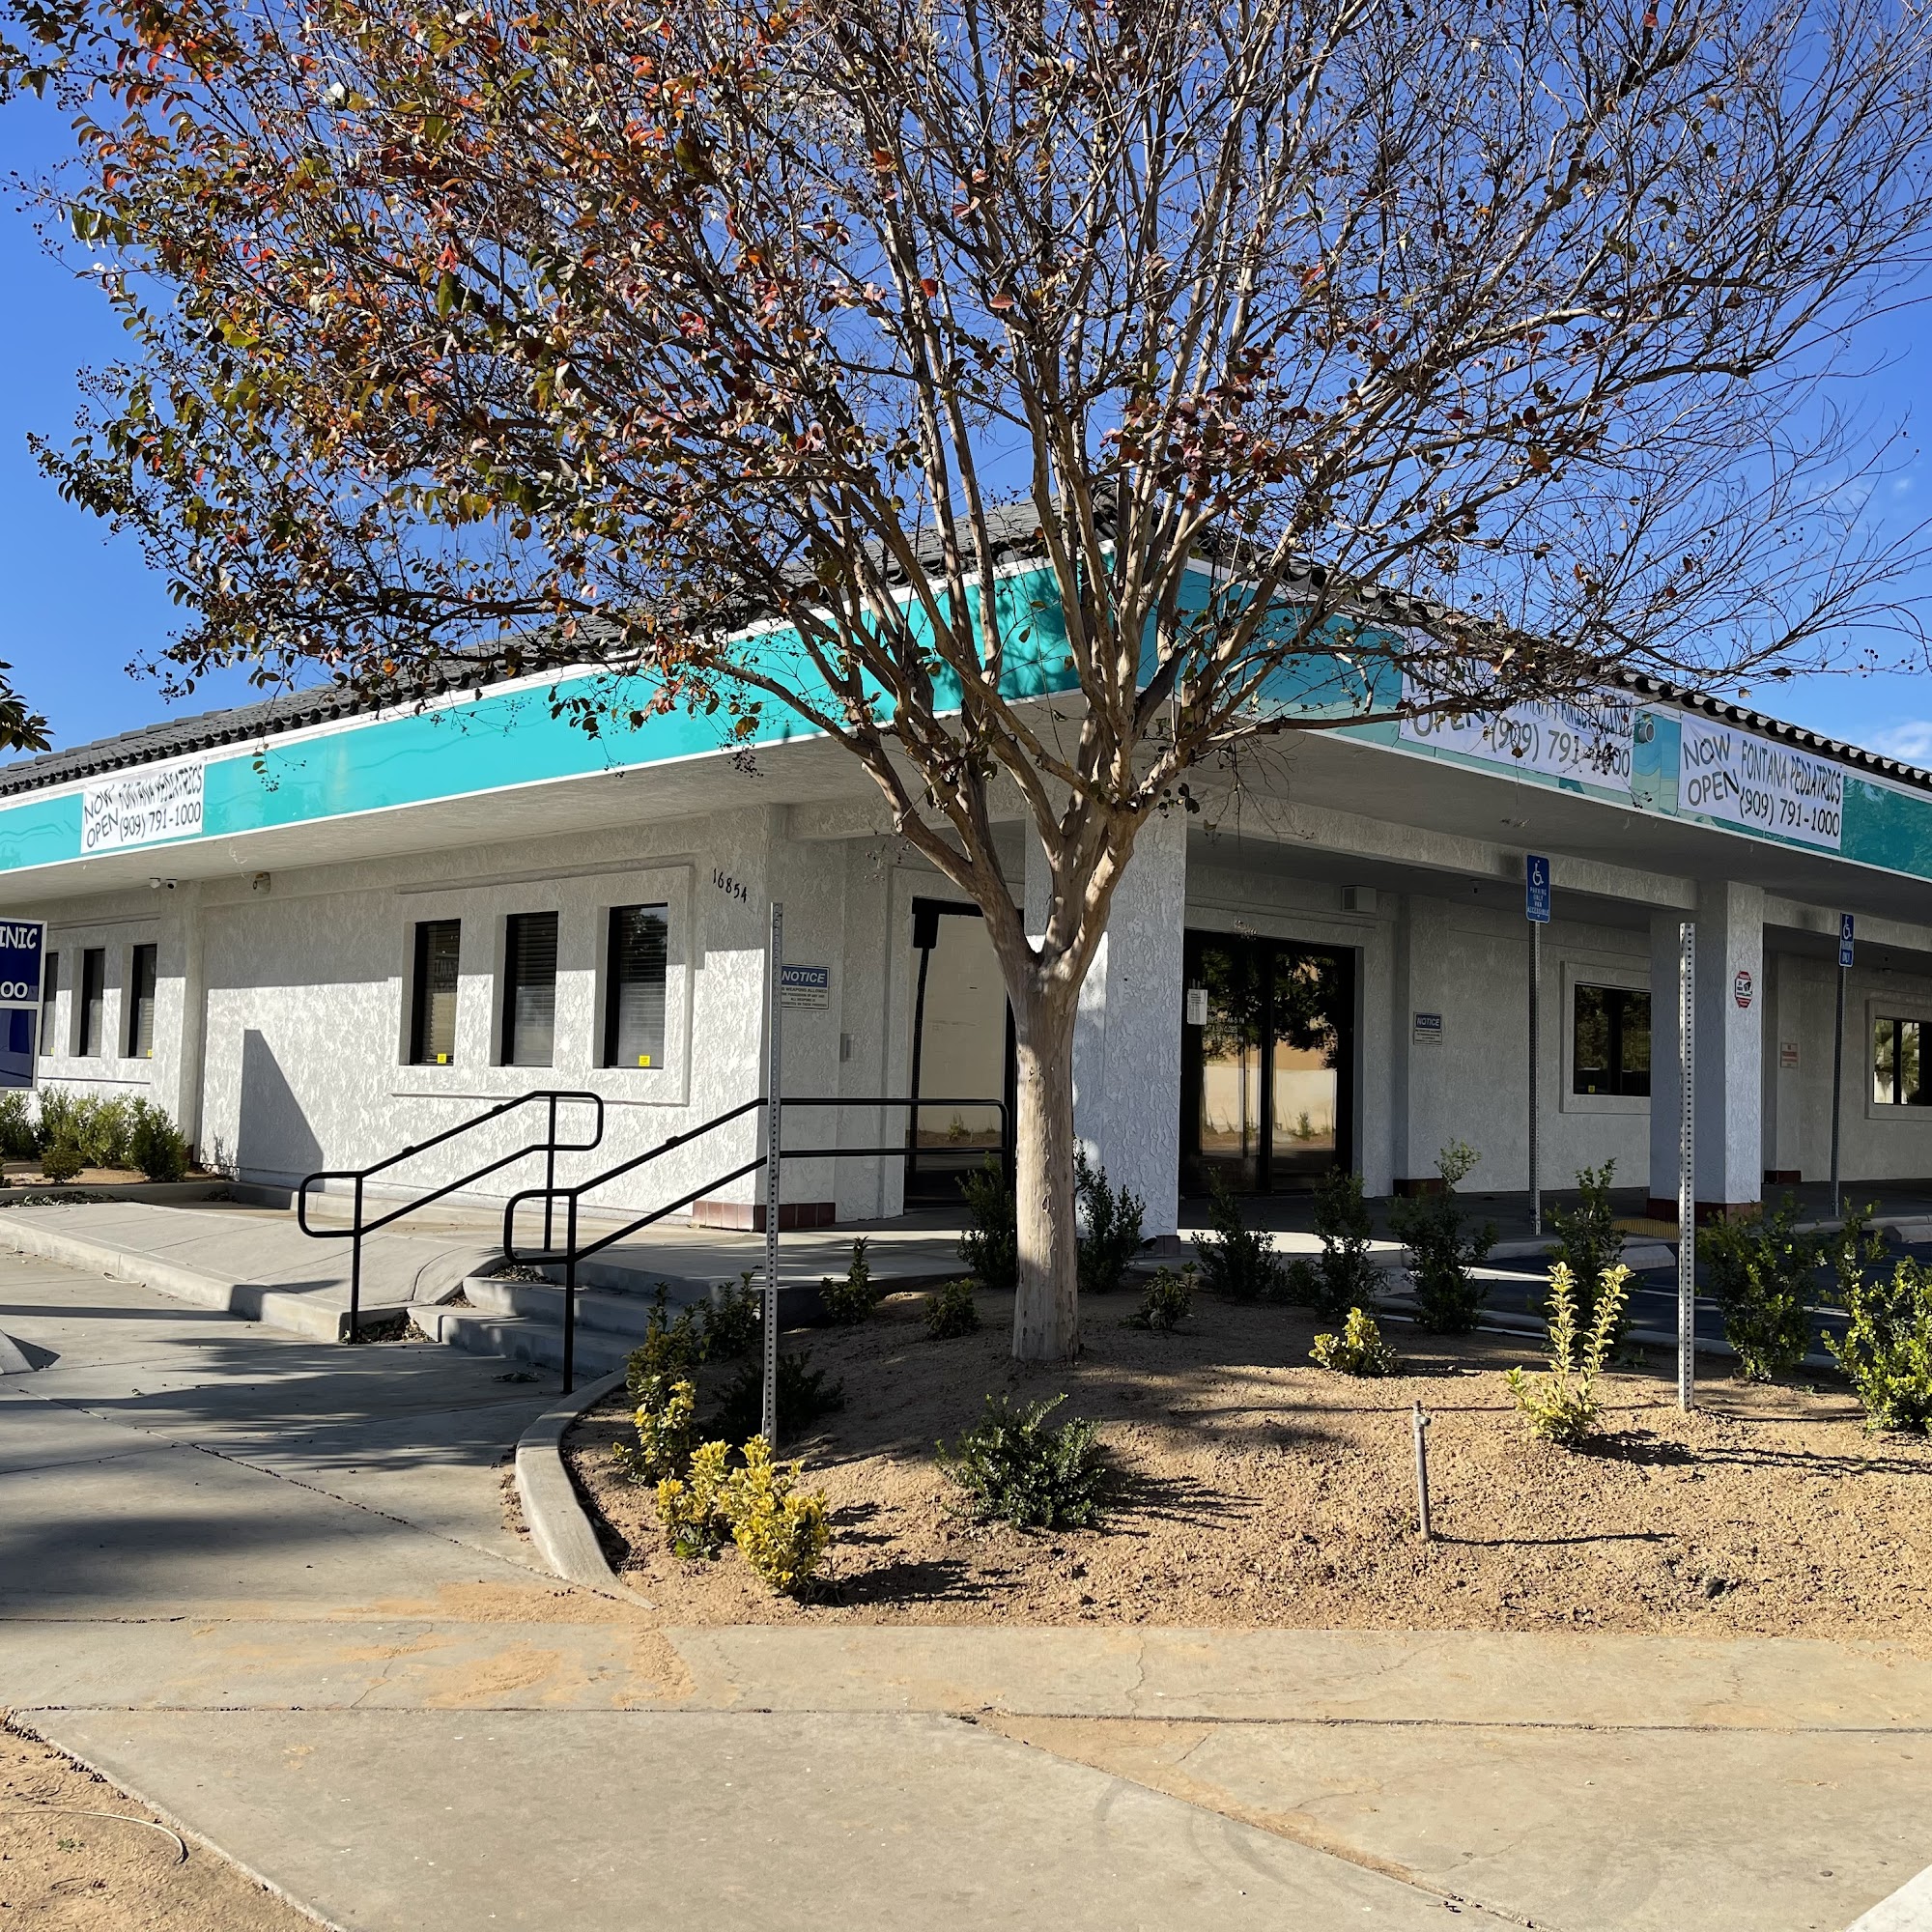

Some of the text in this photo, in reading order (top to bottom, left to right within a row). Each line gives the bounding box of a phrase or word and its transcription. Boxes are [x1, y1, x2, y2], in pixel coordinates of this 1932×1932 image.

[1492, 717, 1631, 778] (909) 79100
[1683, 733, 1730, 770] NOW
[1688, 769, 1739, 806] OPEN
[1741, 740, 1841, 806] FONTANA PEDIATRICS
[84, 783, 115, 824] NOW
[120, 801, 201, 842] (909) 791-1000
[1739, 786, 1840, 838] (909) 791-1000
[87, 808, 118, 847] OPEN
[713, 867, 747, 903] 16854
[781, 971, 826, 983] NOTICE
[1417, 1017, 1440, 1026] NOTICE
